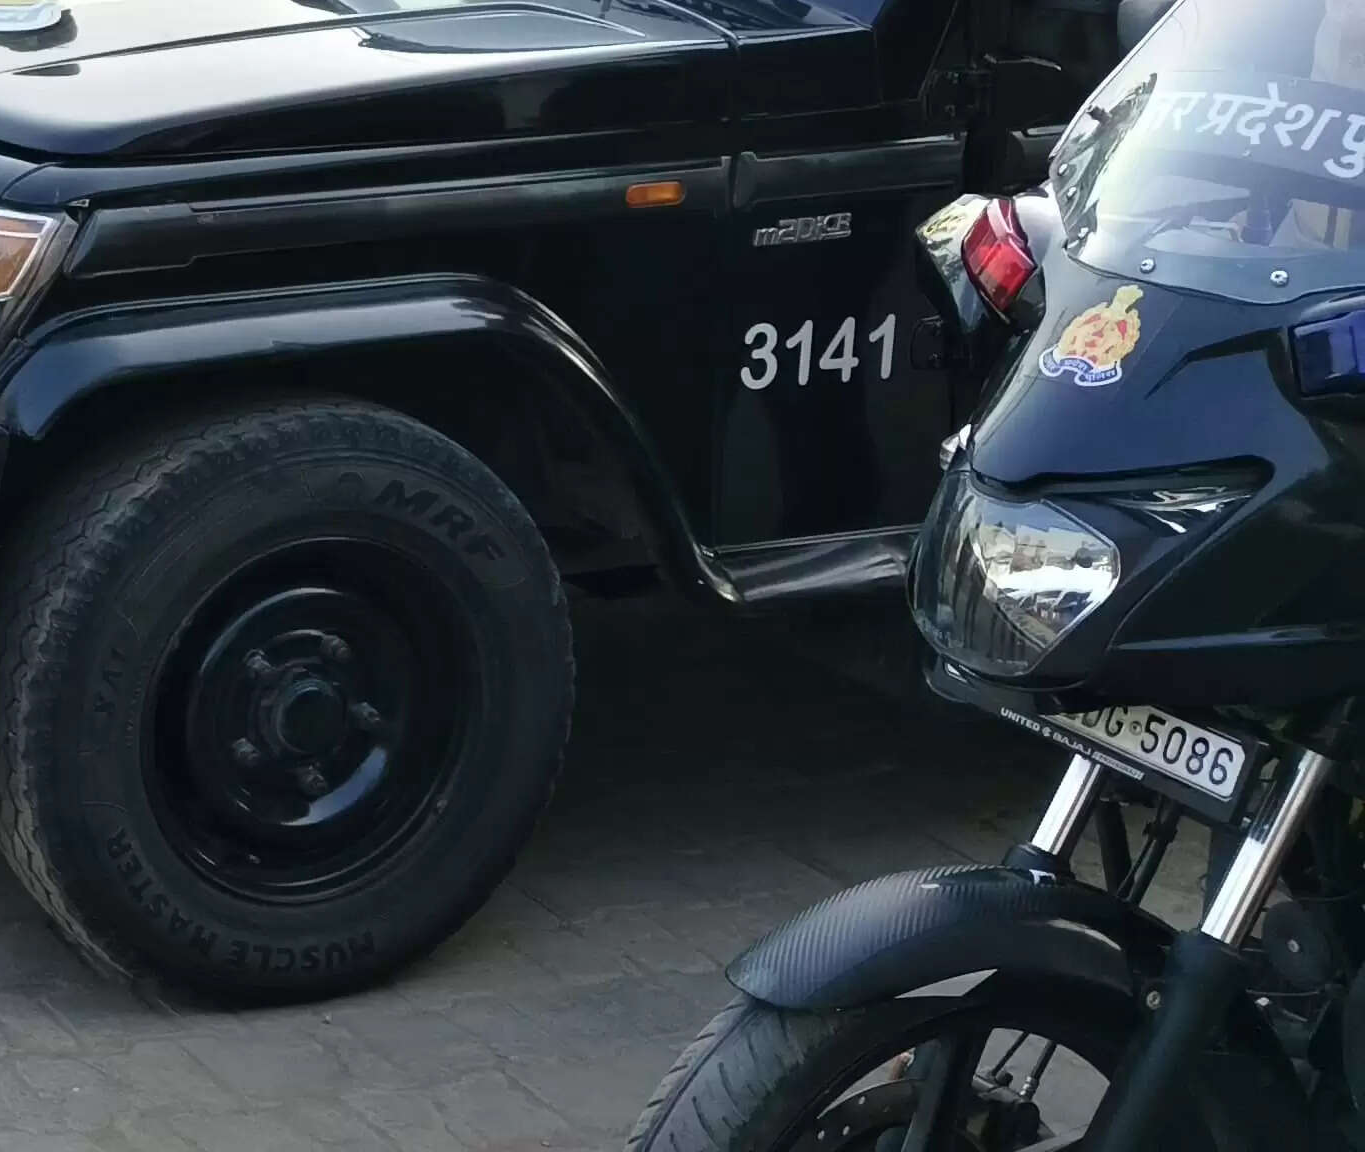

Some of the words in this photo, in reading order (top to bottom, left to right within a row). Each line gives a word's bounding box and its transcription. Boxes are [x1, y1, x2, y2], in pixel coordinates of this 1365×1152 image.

[740, 313, 896, 391] 3141
[1000, 706, 1040, 732] UNITED
[1140, 712, 1235, 786] 5086
